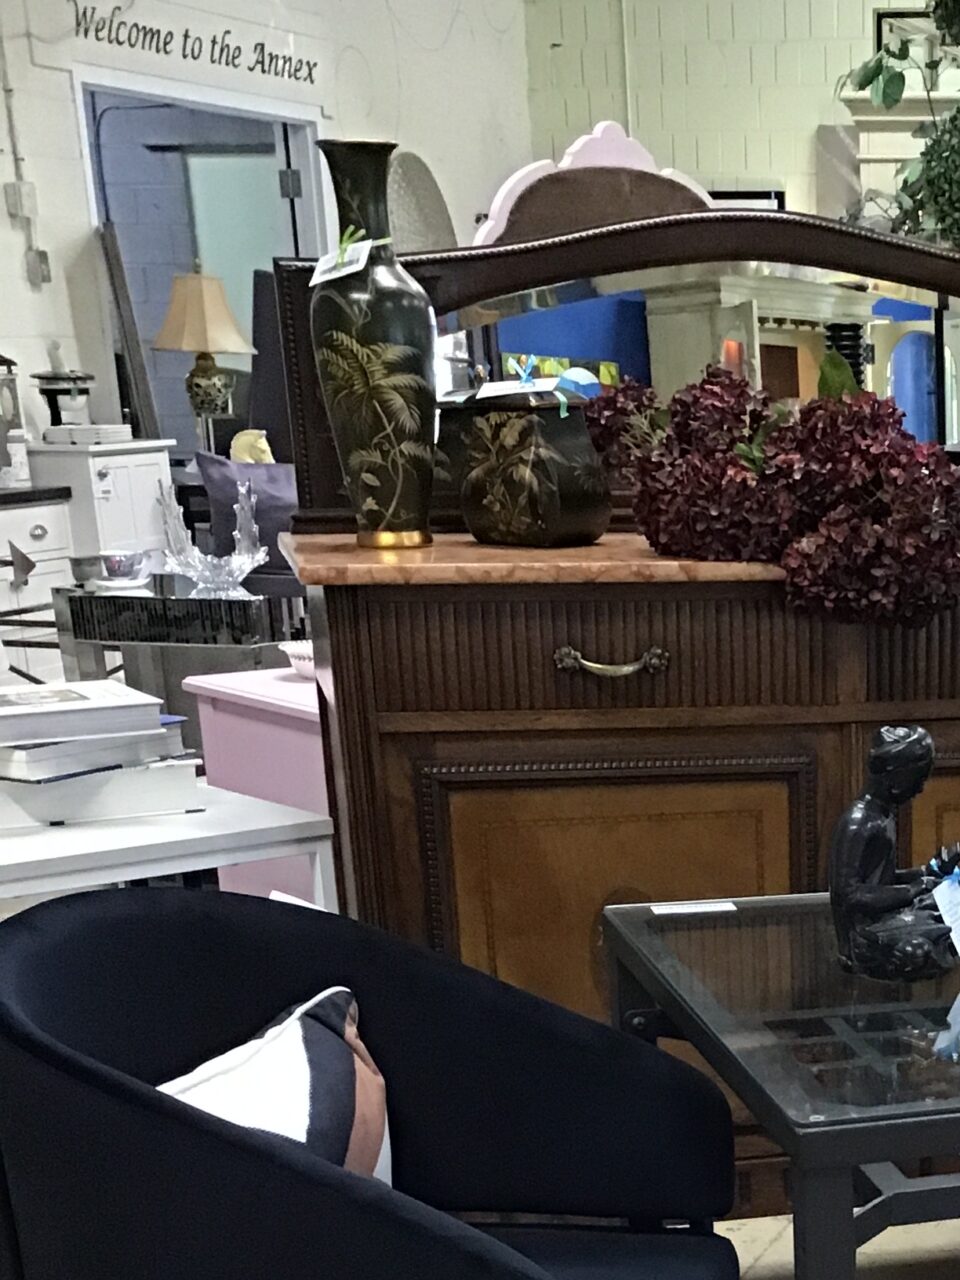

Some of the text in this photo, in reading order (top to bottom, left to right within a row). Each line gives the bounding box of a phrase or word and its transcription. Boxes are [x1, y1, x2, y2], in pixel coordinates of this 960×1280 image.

[67, 0, 318, 84] Welcome to the Annex
